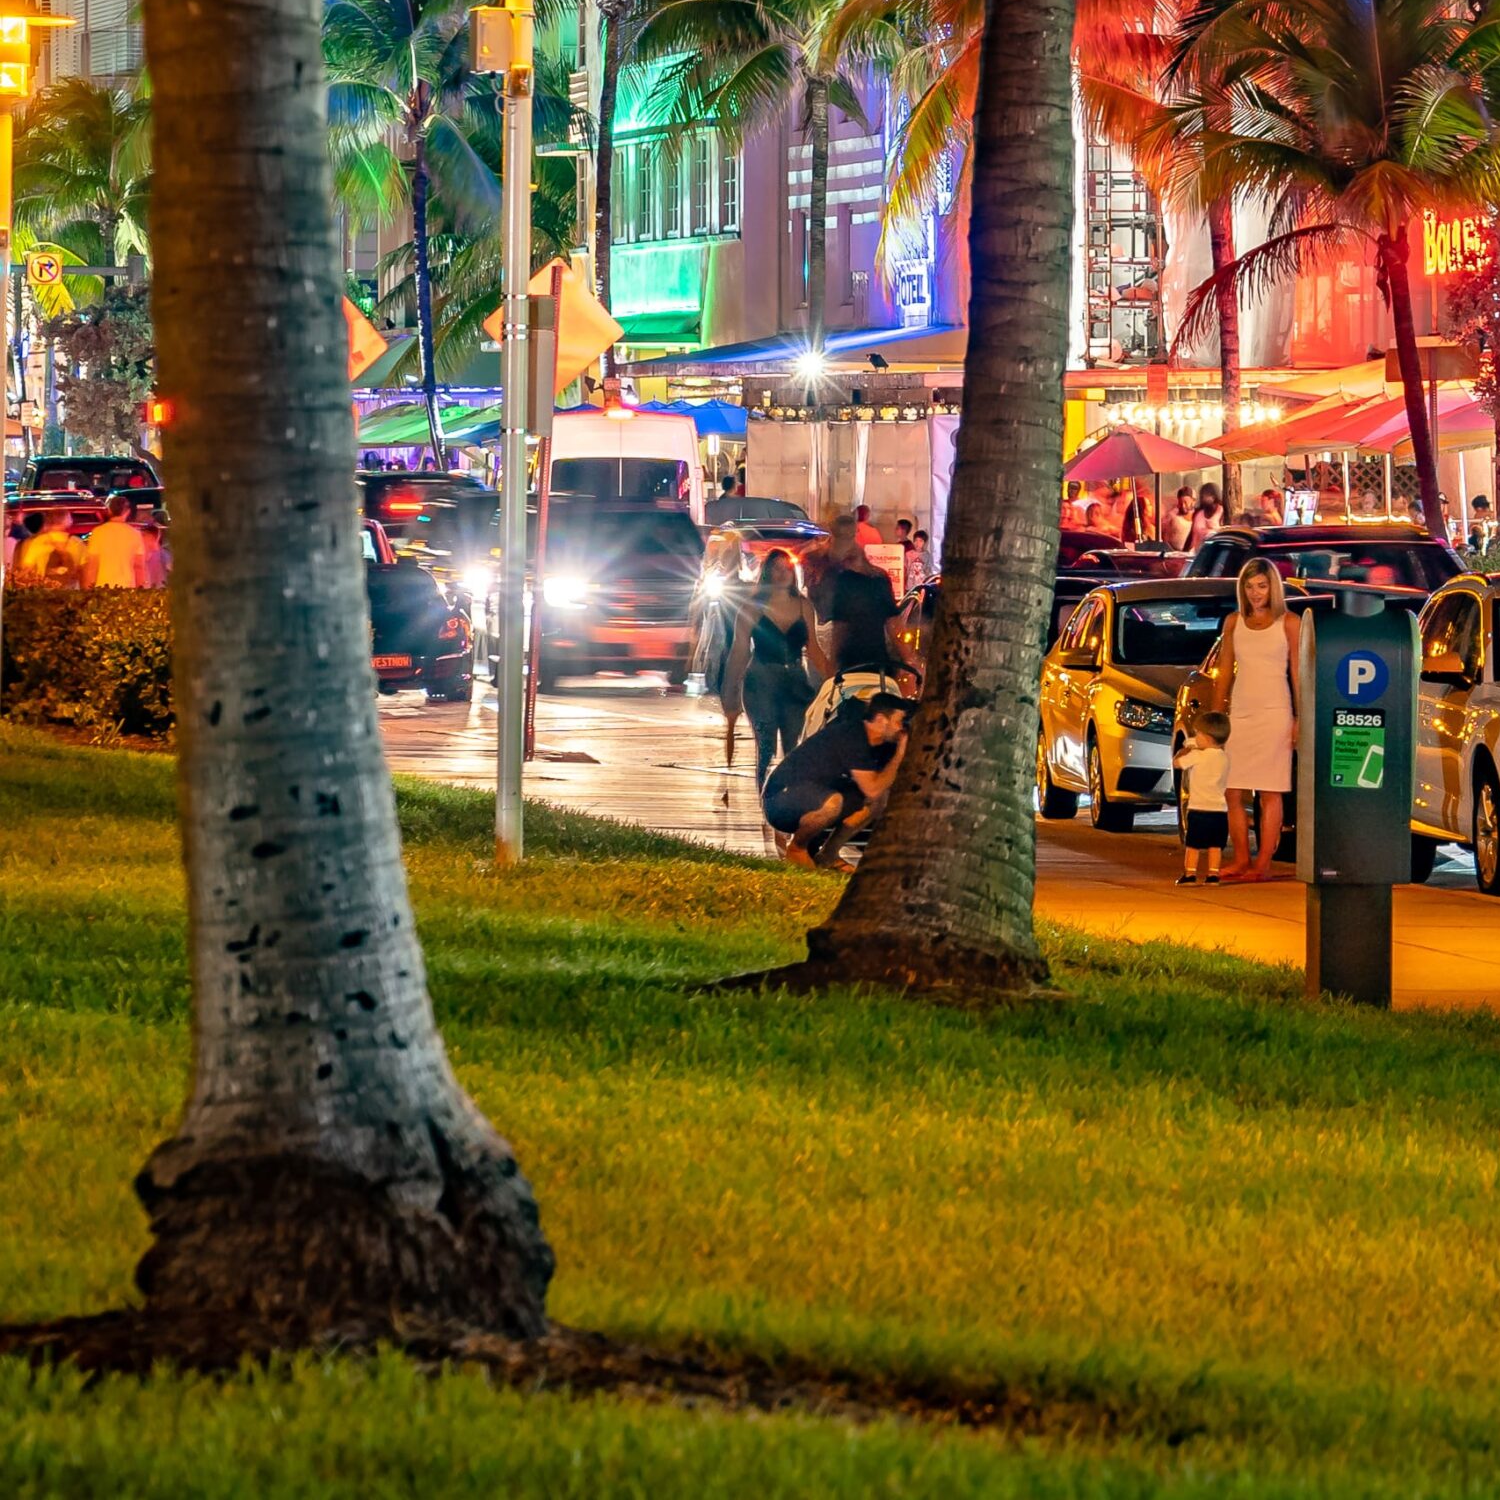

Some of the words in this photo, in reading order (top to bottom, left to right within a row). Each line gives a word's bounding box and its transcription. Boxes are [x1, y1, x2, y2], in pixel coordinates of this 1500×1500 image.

[895, 271, 926, 307] HOTEL
[1348, 659, 1376, 695] P
[1336, 714, 1382, 727] 88526
